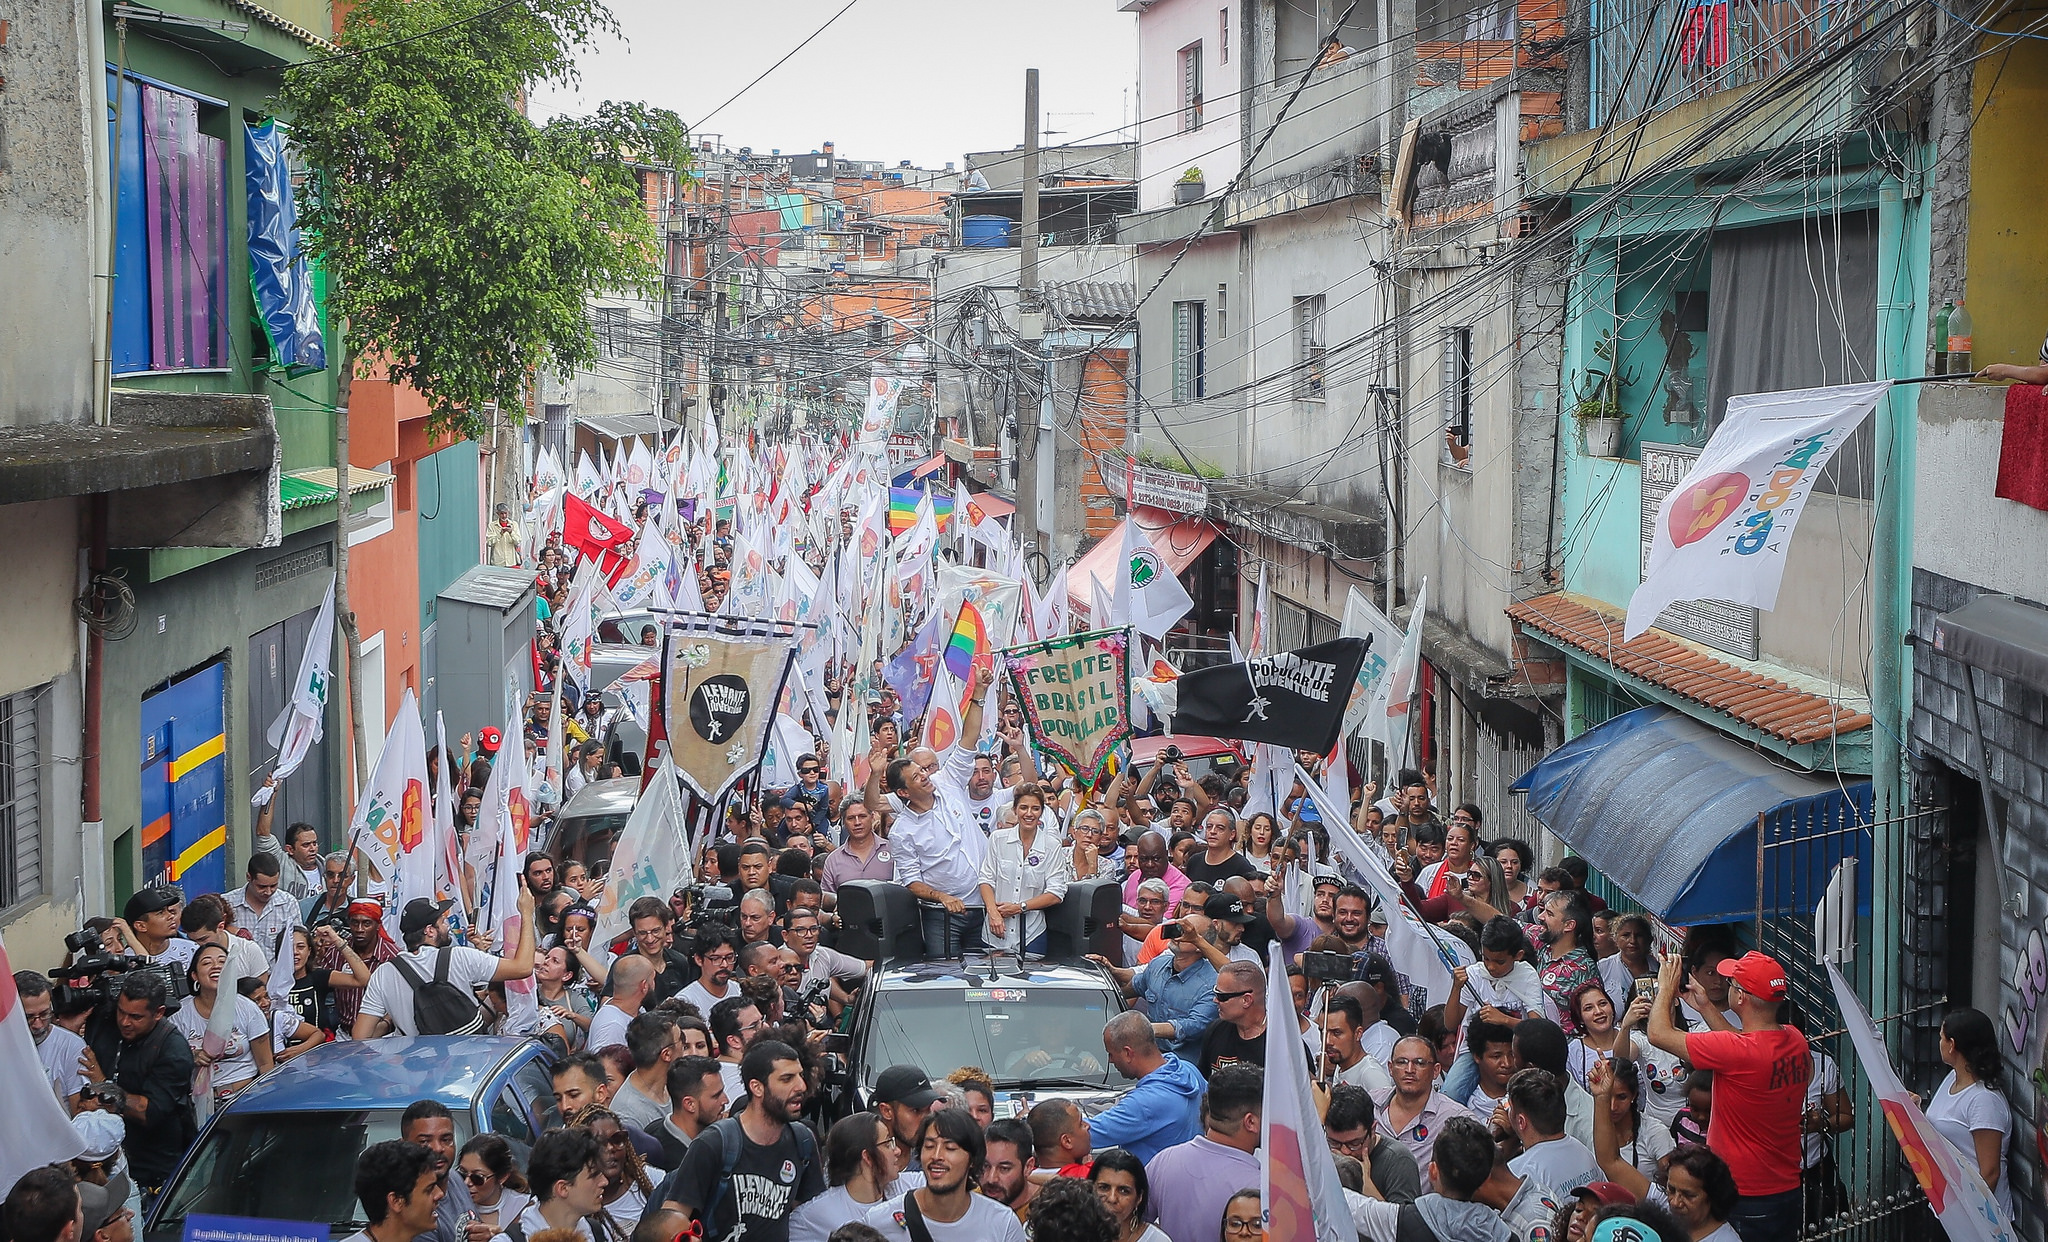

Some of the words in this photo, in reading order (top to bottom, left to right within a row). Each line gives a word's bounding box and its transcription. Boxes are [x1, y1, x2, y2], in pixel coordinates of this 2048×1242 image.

[1027, 653, 1113, 685] FRENTE
[1034, 681, 1114, 712] BRASIL
[1255, 674, 1330, 703] JUVENTUDE
[1041, 706, 1119, 742] POPULAR
[784, 1161, 792, 1172] 13
